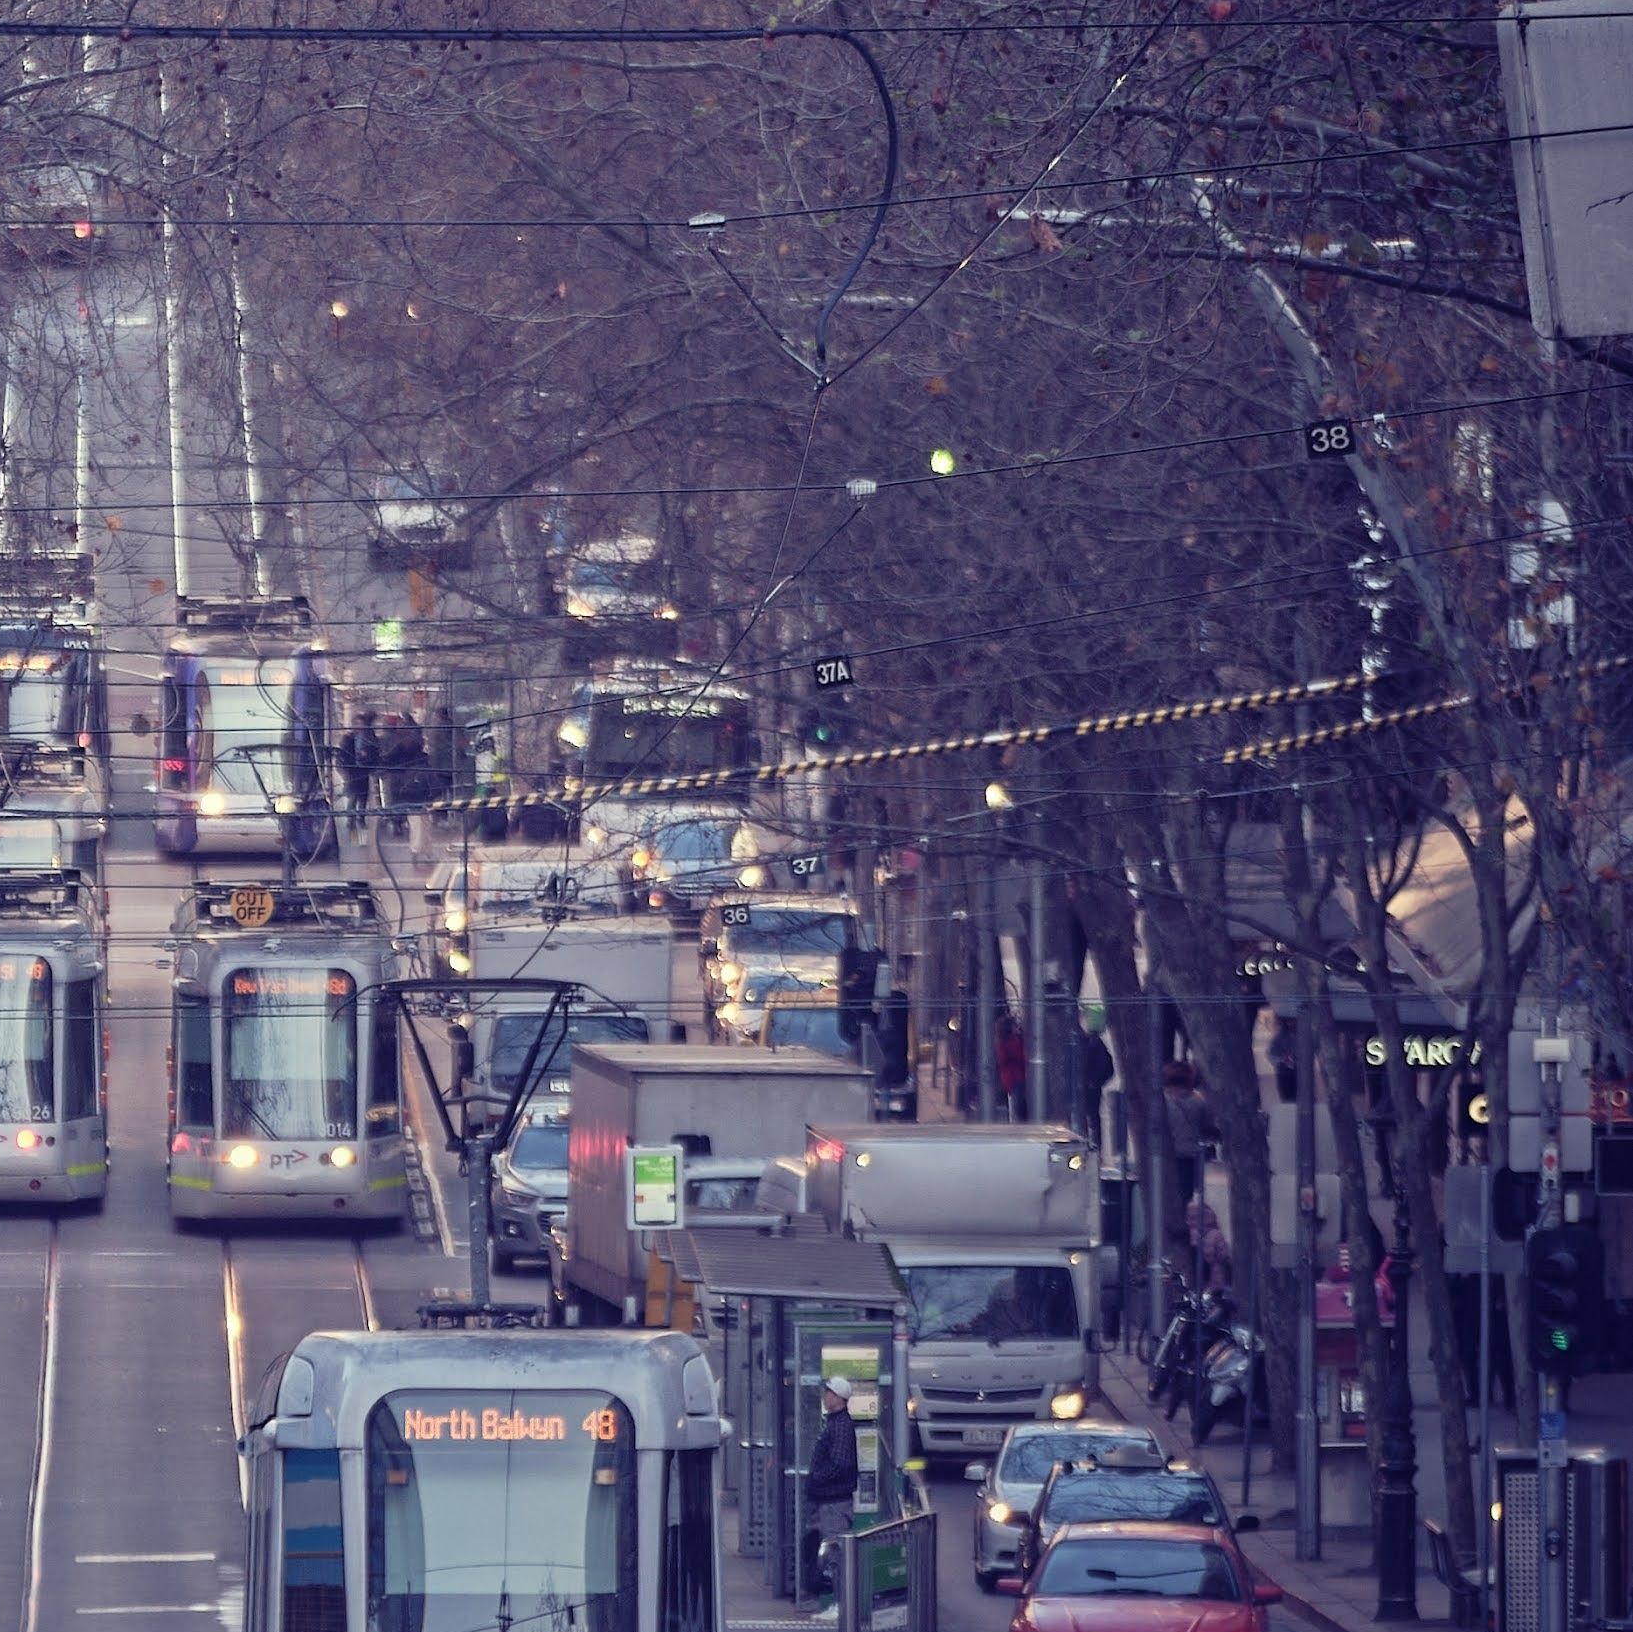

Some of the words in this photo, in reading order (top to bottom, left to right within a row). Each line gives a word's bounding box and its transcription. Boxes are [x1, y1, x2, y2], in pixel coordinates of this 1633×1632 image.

[1311, 426, 1350, 452] 38
[817, 661, 850, 684] 37A
[792, 857, 818, 874] 37
[236, 892, 266, 906] CUT
[236, 907, 266, 920] OFF
[723, 908, 748, 924] 36
[404, 1408, 476, 1440] North
[481, 1407, 565, 1440] Balwyn
[581, 1410, 616, 1440] 48
